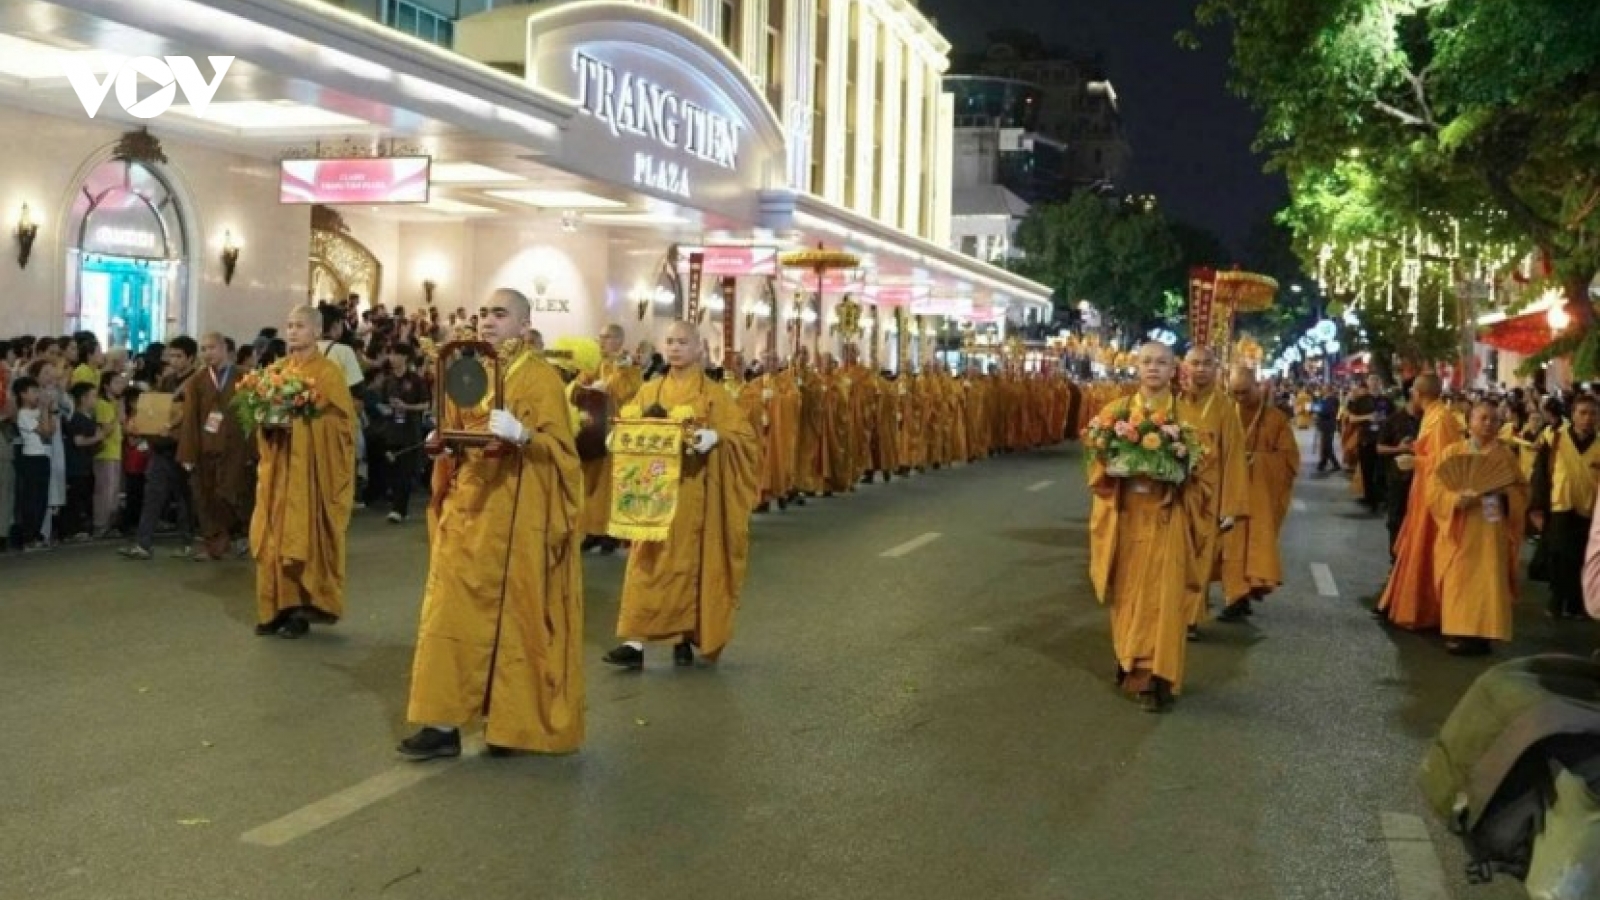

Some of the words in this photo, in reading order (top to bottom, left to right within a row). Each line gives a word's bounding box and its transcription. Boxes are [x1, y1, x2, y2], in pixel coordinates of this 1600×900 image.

[571, 49, 680, 148] TRANG
[681, 98, 742, 171] TIEN
[632, 152, 691, 198] PLAZA
